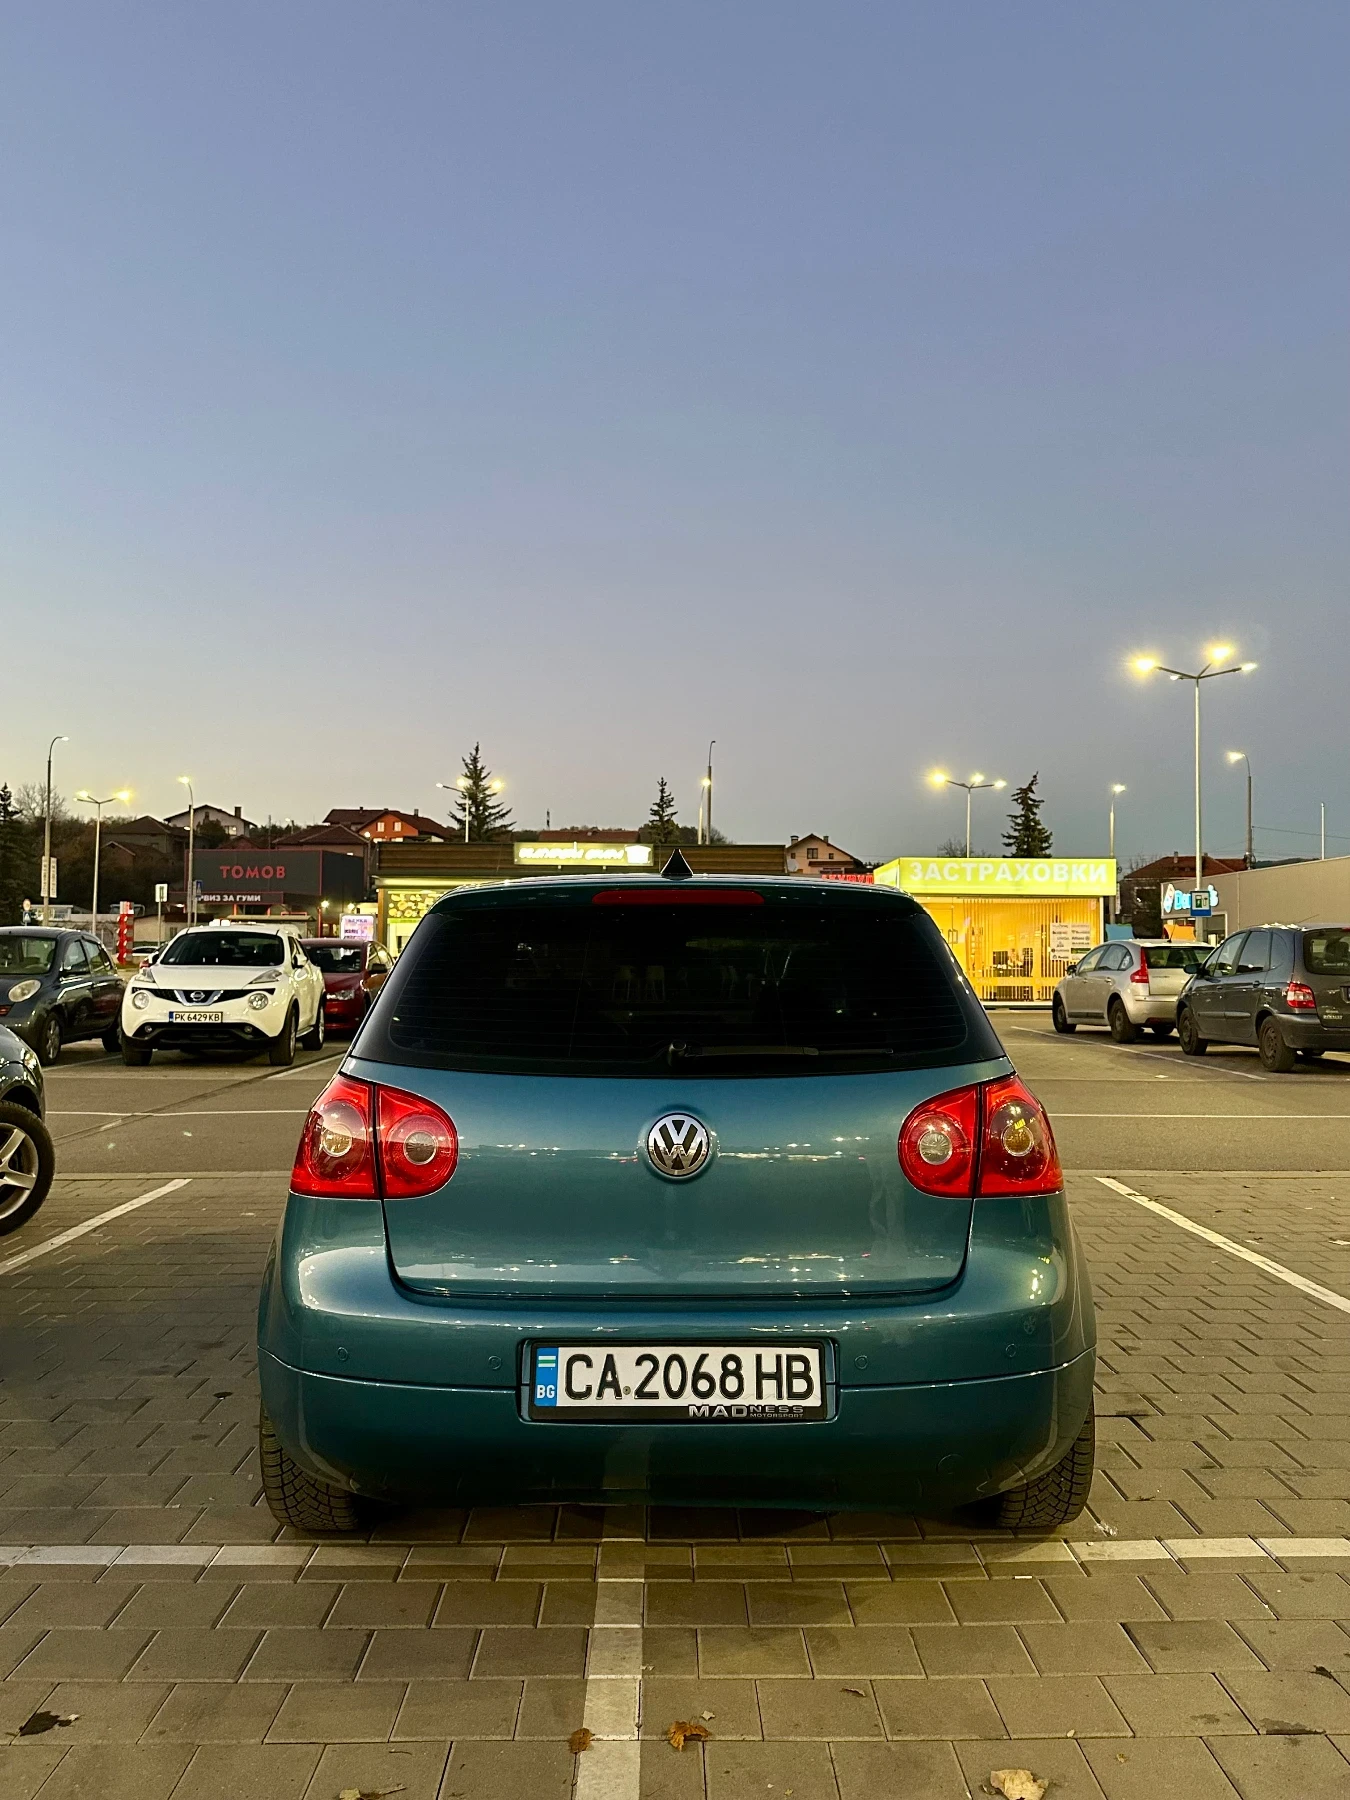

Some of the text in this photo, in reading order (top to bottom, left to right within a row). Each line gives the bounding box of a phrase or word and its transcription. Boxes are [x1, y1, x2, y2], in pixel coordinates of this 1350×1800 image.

[220, 865, 286, 879] ТОМОВ
[910, 862, 1107, 883] ЗАСТРАХОВКИ
[222, 894, 235, 902] ЗА
[236, 894, 261, 902] ГУМИ
[187, 1013, 208, 1022] 6429
[565, 1353, 815, 1400] CA 2068 HB
[536, 1384, 556, 1399] BG
